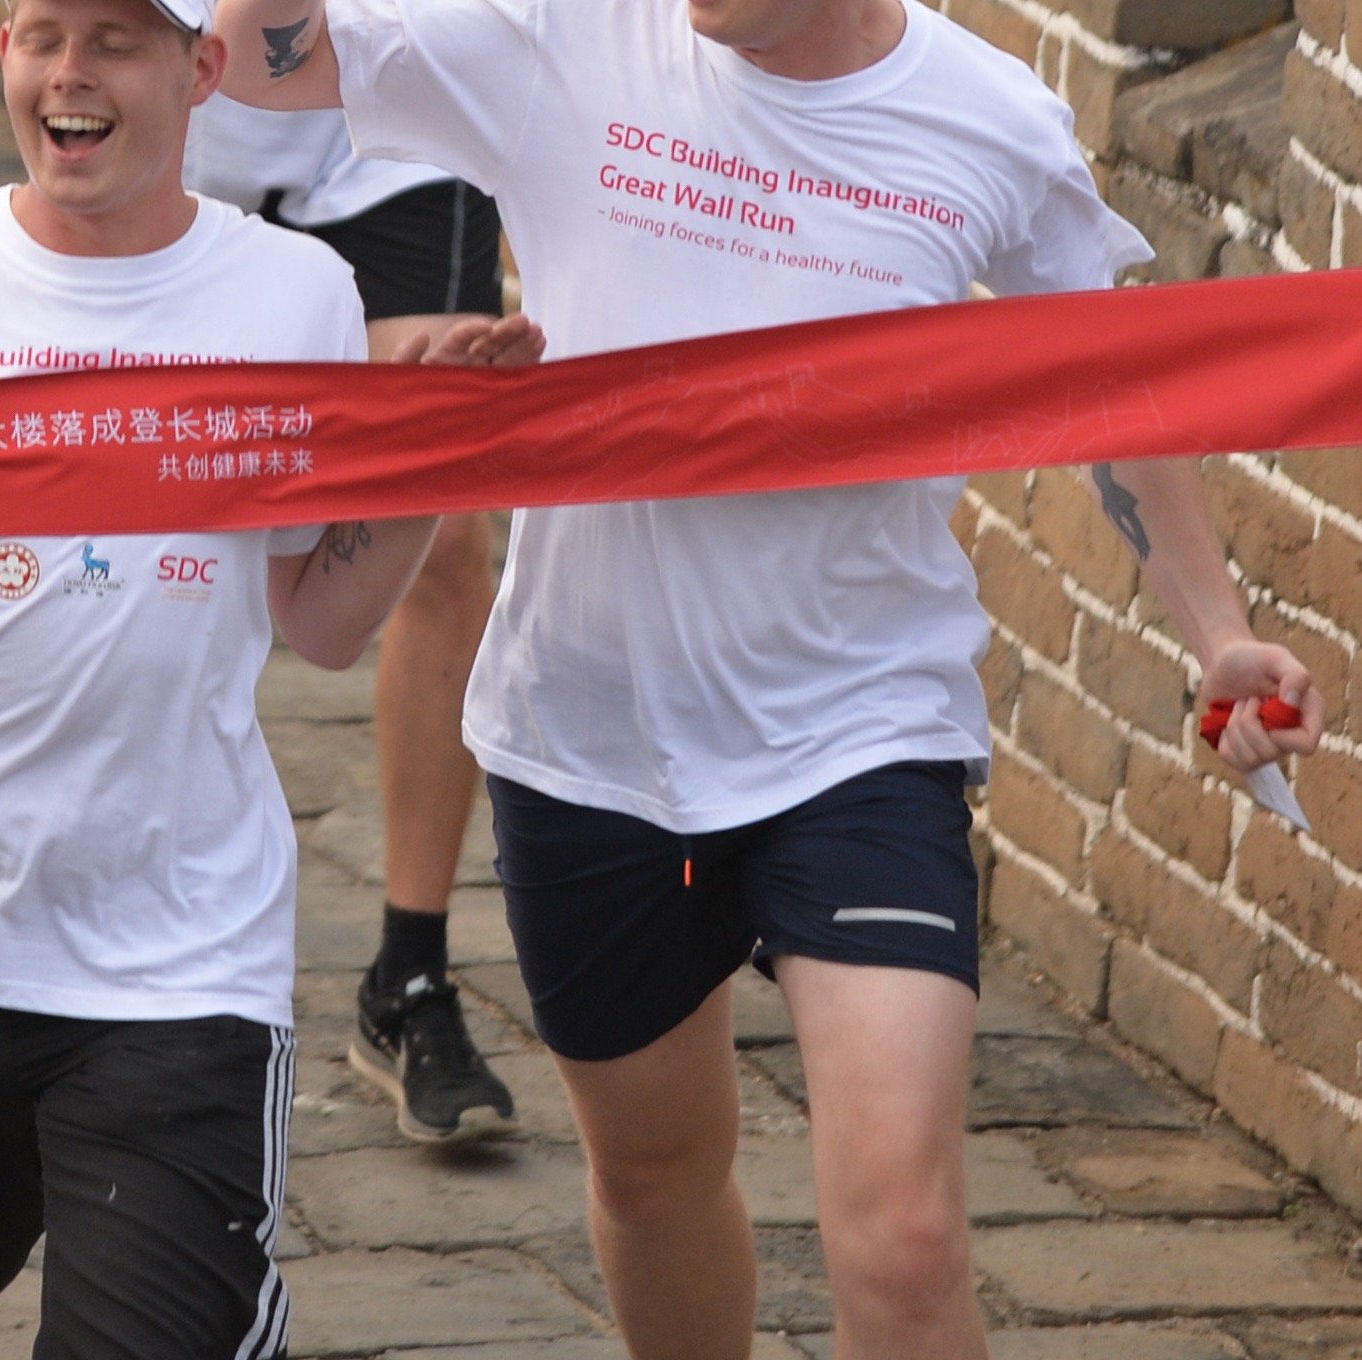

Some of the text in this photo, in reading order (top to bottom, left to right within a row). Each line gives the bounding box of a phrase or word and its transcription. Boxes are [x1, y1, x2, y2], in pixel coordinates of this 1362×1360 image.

[598, 163, 796, 235] Great Wall Run
[604, 121, 967, 232] SDC Building Inauguration
[609, 205, 666, 238] Joining
[669, 222, 726, 252] forces
[729, 237, 756, 258] for
[759, 247, 771, 262] a
[774, 249, 845, 276] healthy
[848, 259, 904, 287] future
[157, 446, 315, 483] 共创健康未来
[156, 554, 219, 584] SDC
